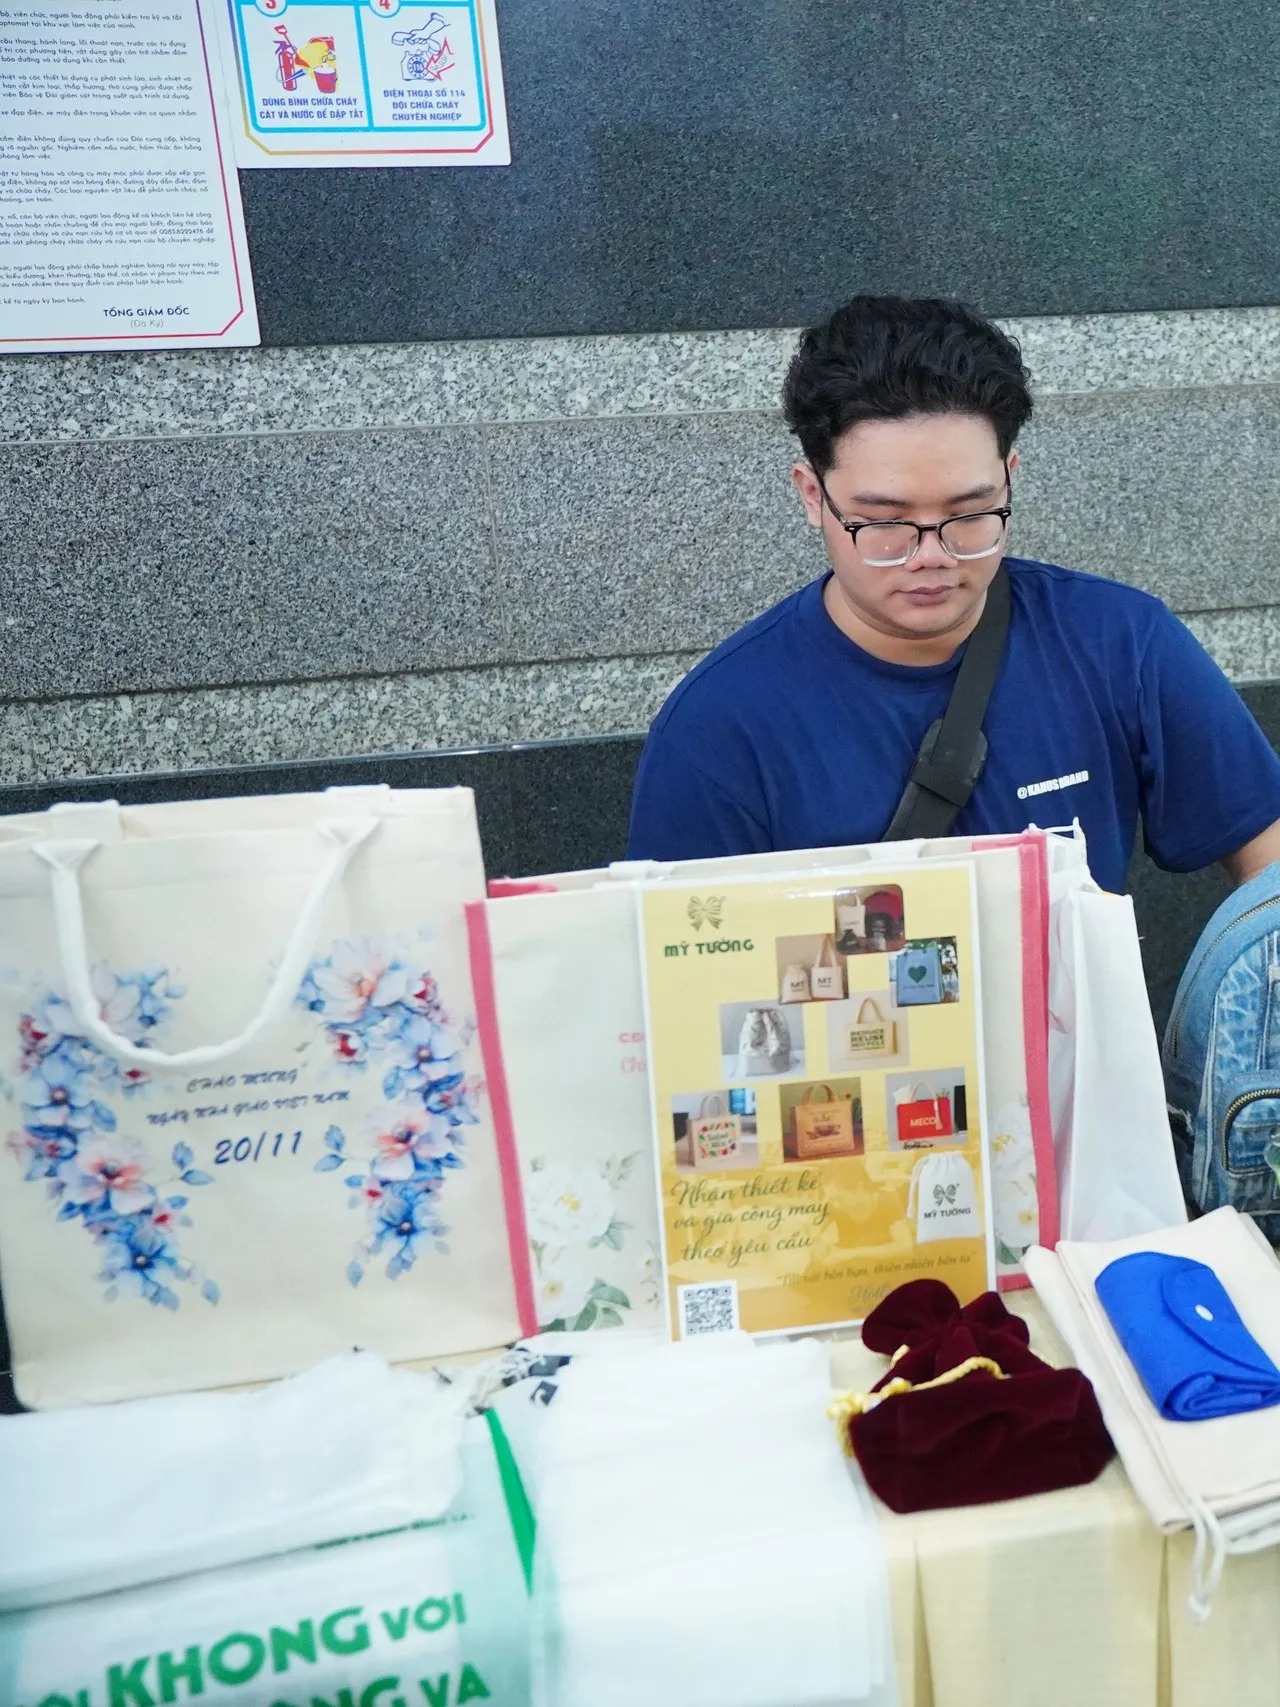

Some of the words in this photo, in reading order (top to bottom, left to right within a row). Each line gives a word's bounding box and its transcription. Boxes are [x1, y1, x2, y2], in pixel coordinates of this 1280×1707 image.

[102, 306, 134, 317] TỔNG
[136, 306, 164, 316] GIÁM
[166, 305, 190, 316] ĐỐC
[664, 940, 689, 957] MỸ
[214, 1130, 302, 1164] 20/11
